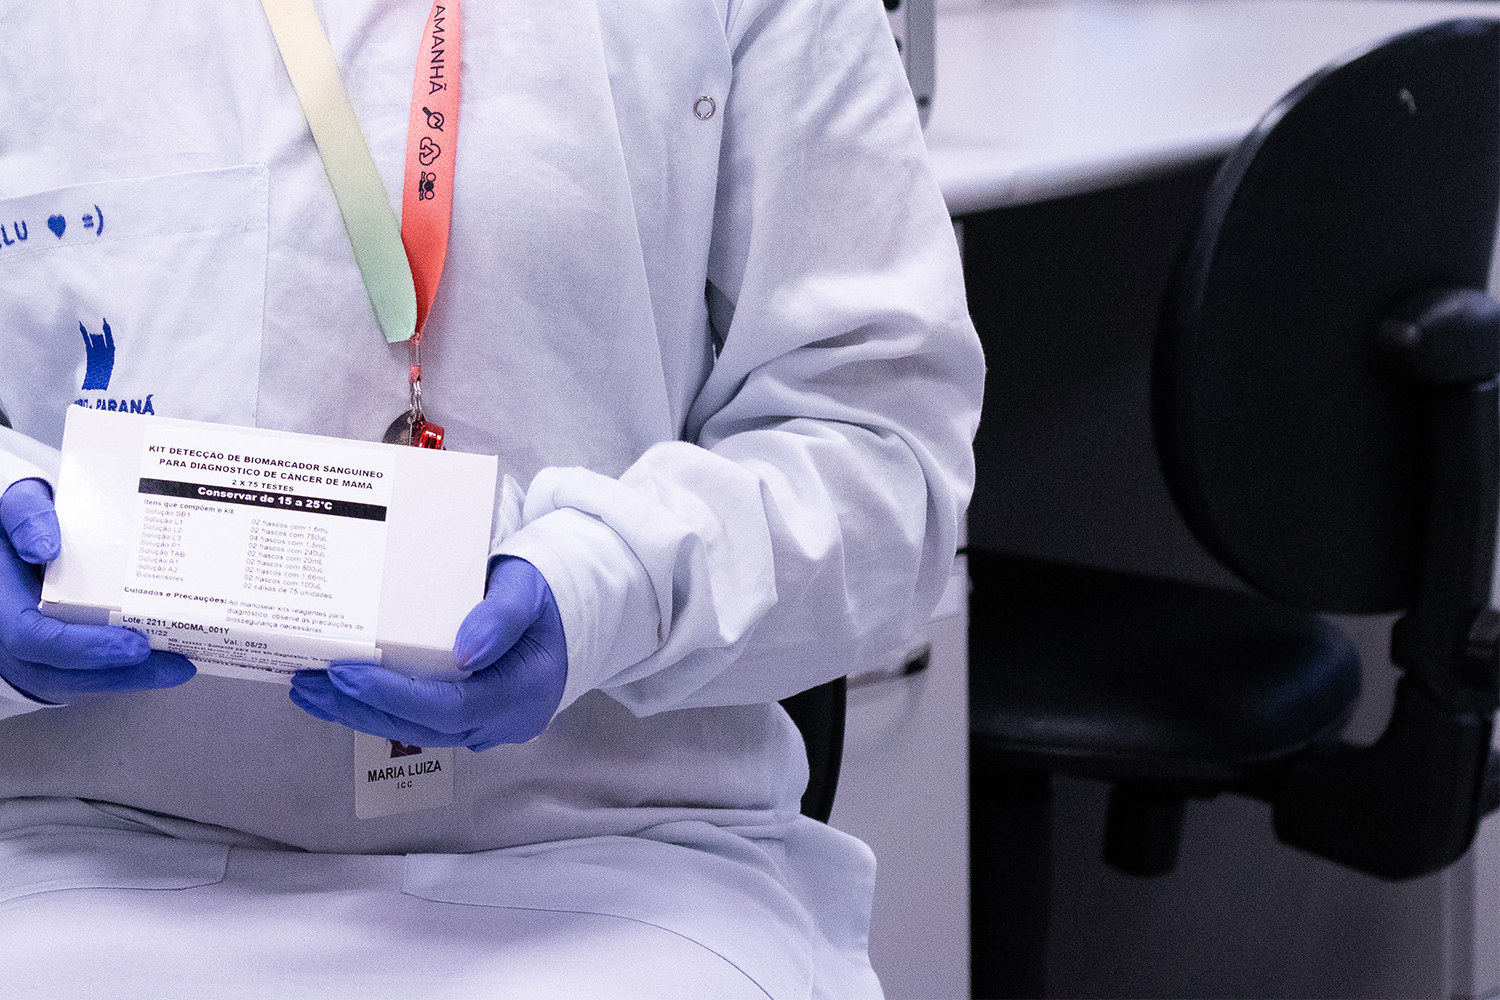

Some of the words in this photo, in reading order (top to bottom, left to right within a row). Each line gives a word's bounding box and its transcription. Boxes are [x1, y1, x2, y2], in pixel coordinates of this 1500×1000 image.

[429, 5, 448, 95] AMANHÃ
[148, 445, 166, 453] KIT
[227, 454, 241, 462] DE
[244, 456, 320, 471] BIOMARCADOR
[159, 458, 187, 468] PARA
[263, 470, 277, 478] DE
[326, 477, 339, 486] DE
[342, 480, 373, 489] MAMA
[197, 486, 258, 501] Conservar
[260, 494, 275, 503] de
[278, 496, 293, 505] 15
[261, 482, 295, 492] TESTES
[122, 615, 144, 624] Lote:
[145, 628, 168, 637] 11/22
[367, 765, 405, 783] MARIA
[408, 760, 442, 776] LUIZA
